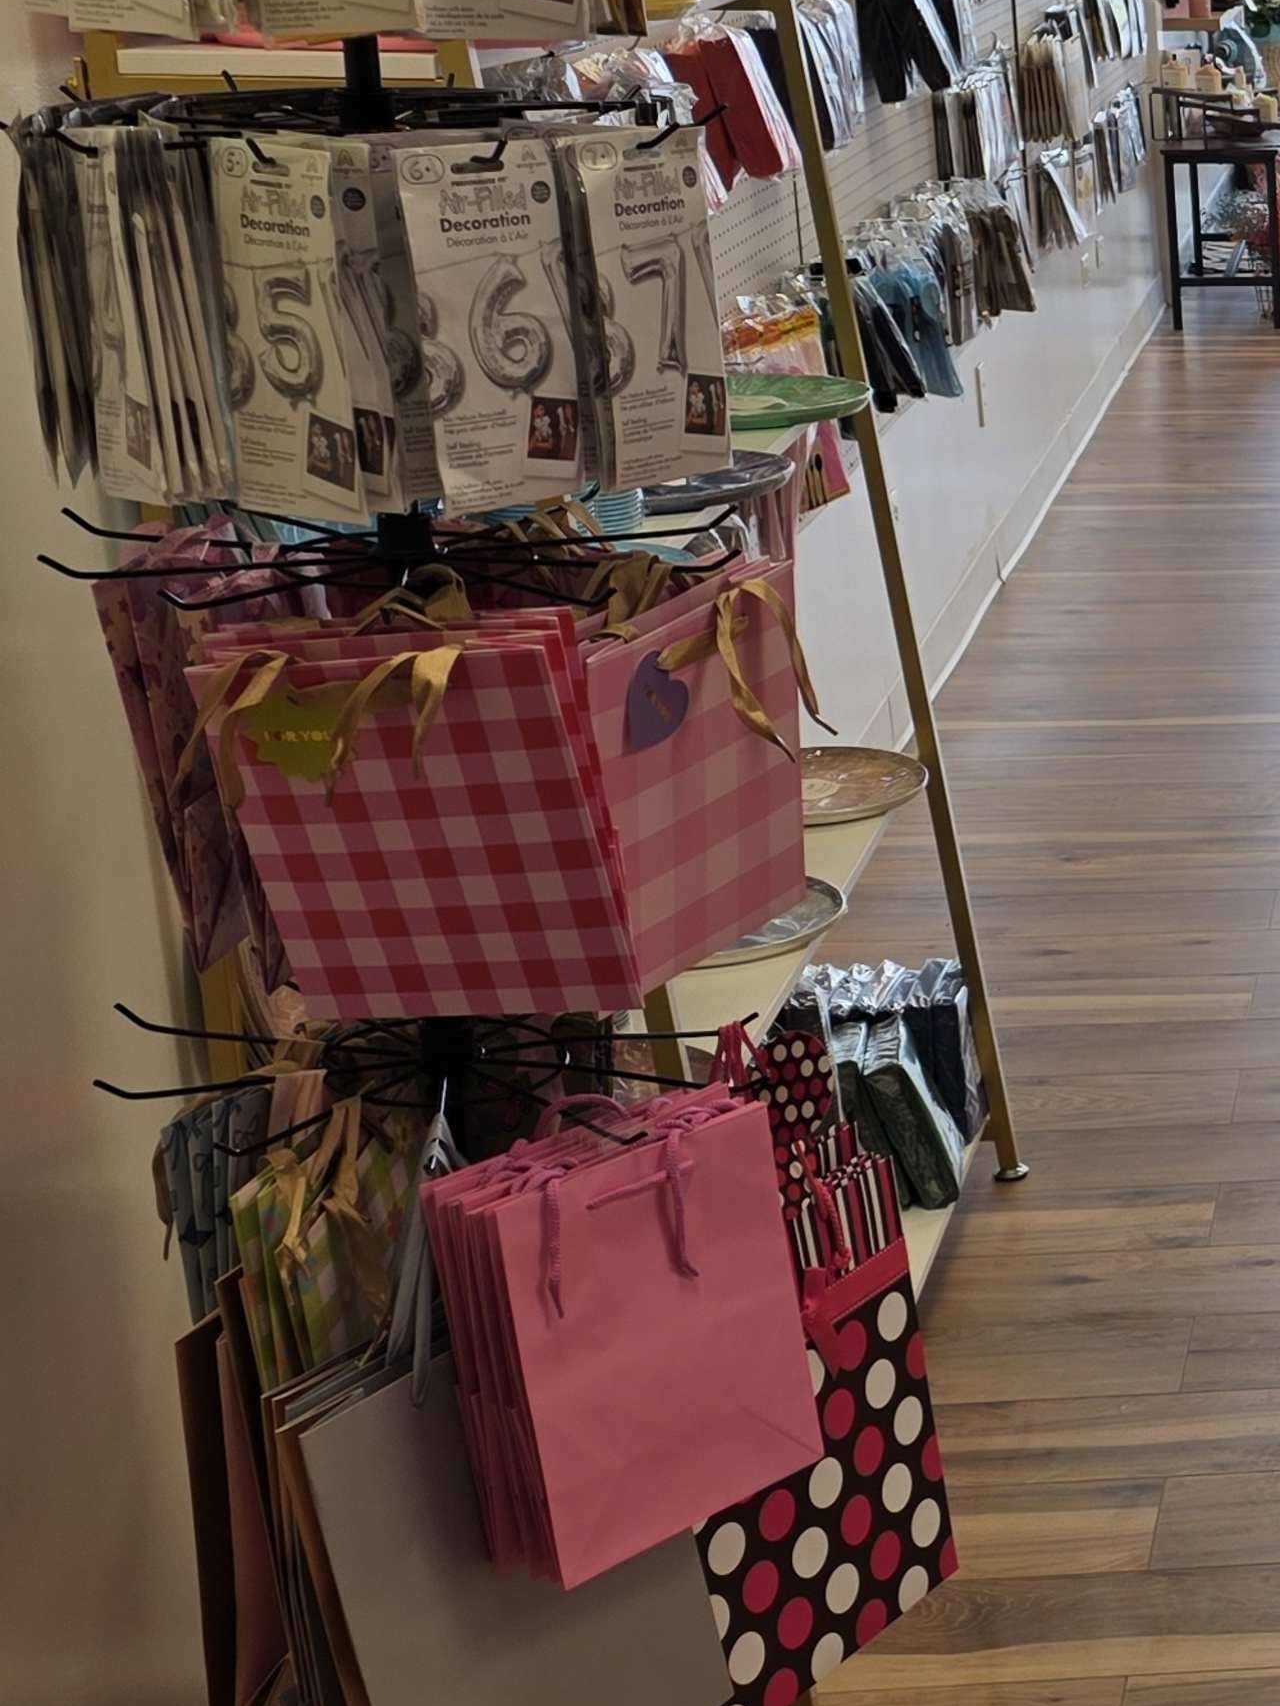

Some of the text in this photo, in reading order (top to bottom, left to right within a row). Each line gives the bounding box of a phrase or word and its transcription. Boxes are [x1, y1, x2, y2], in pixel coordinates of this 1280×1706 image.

[614, 195, 685, 218] Decoration
[240, 213, 311, 237] Decoration
[440, 212, 531, 233] Decoration
